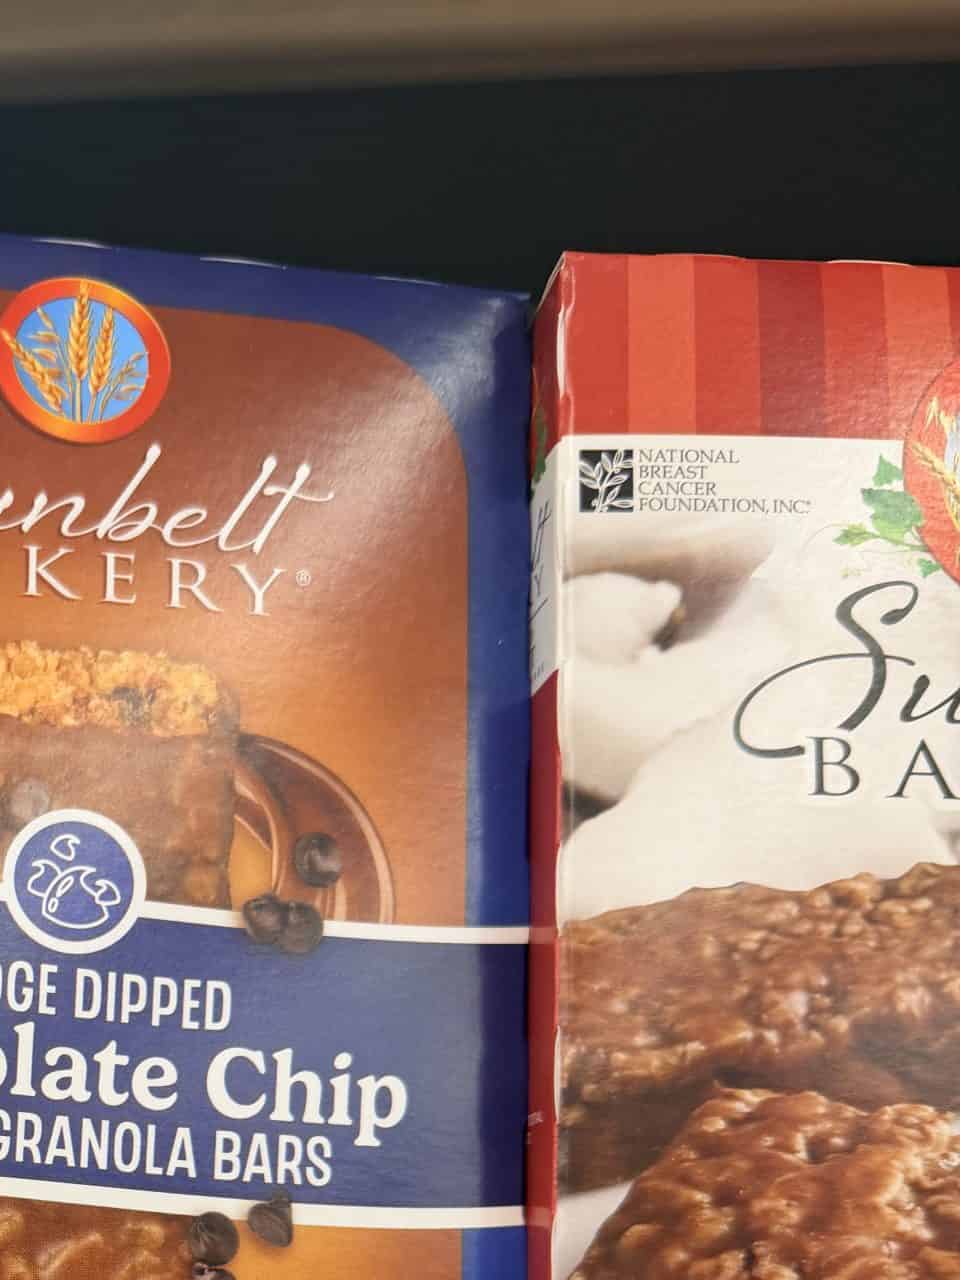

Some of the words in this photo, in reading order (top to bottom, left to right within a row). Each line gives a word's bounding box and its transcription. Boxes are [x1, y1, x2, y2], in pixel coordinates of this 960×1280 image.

[638, 448, 740, 464] NATIONAL
[639, 464, 709, 480] BREAST
[637, 481, 718, 497] CANCER
[806, 735, 960, 801] BA
[74, 968, 233, 1032] DIPPED
[204, 1045, 409, 1149] Chip
[213, 1130, 333, 1187] BARS
